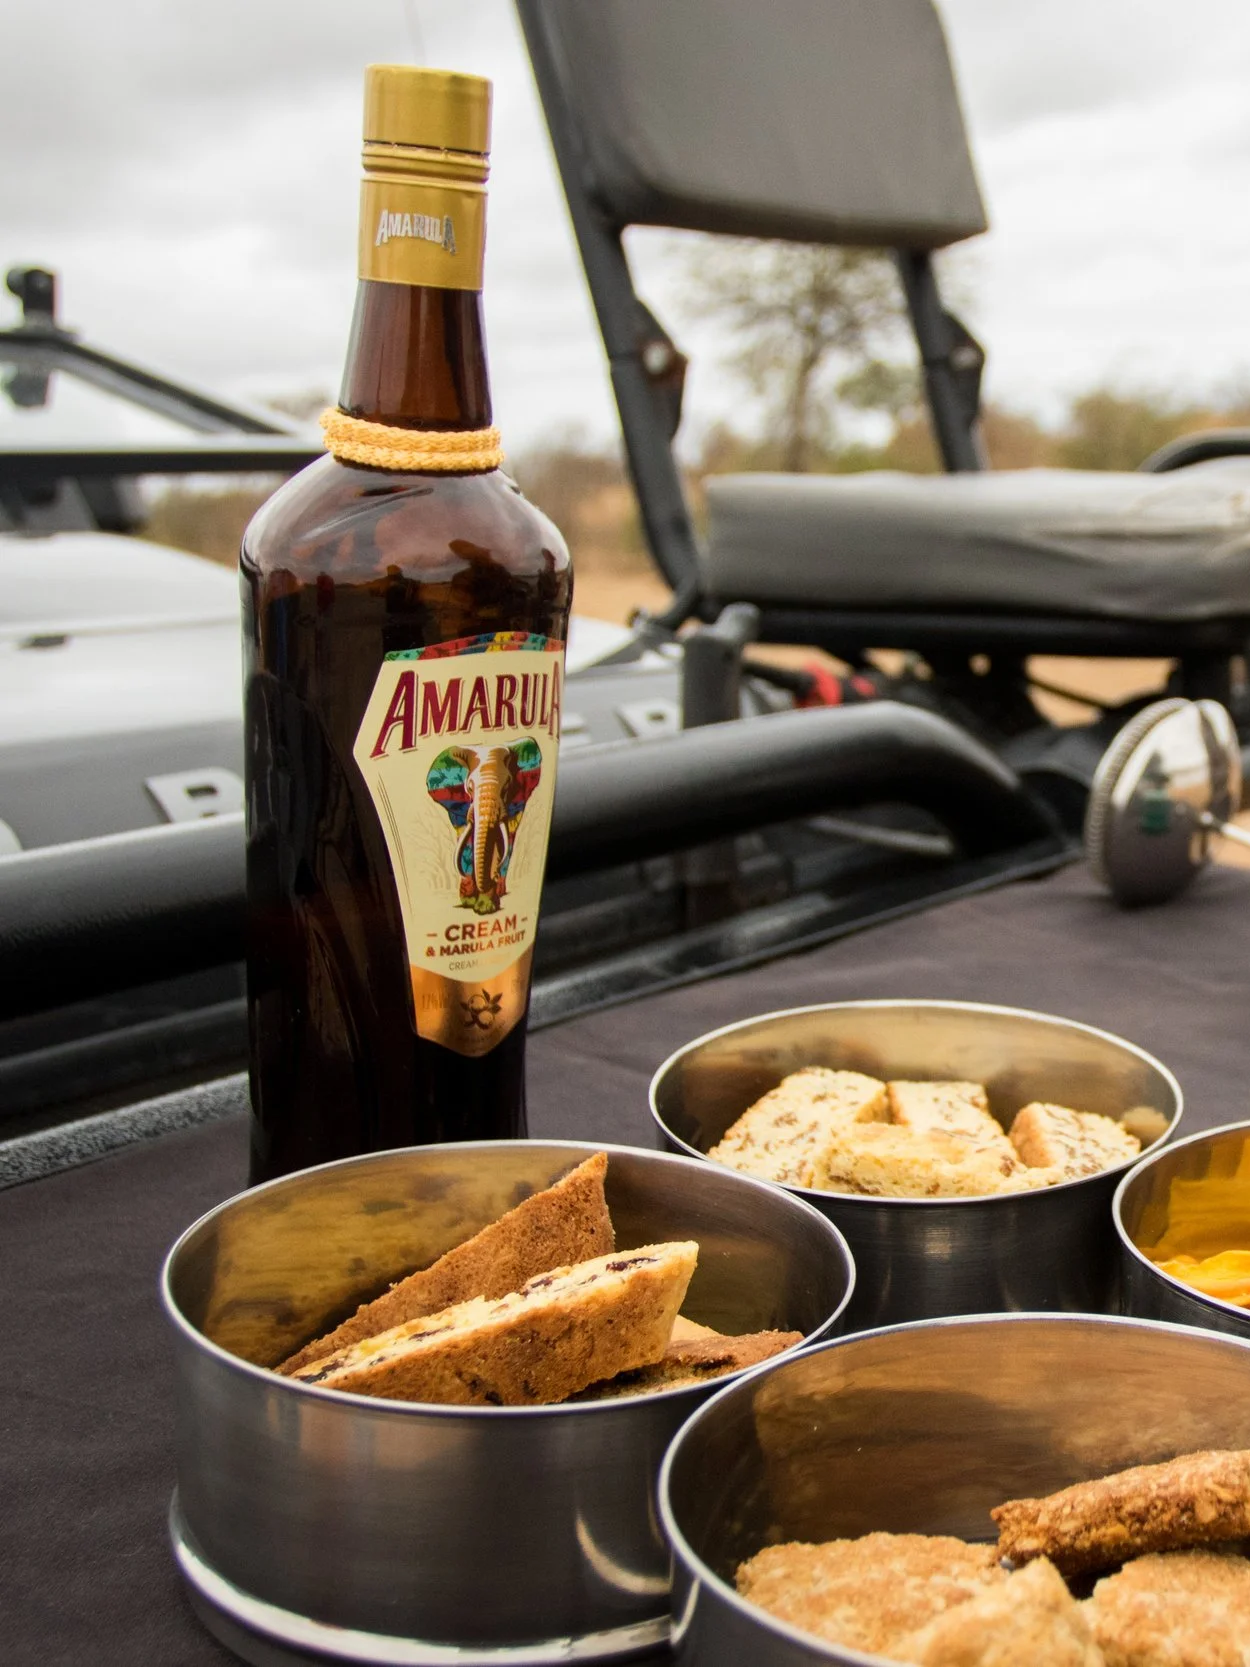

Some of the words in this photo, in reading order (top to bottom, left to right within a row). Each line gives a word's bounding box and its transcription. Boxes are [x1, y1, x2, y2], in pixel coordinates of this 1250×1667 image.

[375, 209, 456, 255] AMARULA
[370, 661, 560, 760] AMARULA
[426, 947, 435, 957] &
[439, 940, 493, 957] MARULA
[498, 930, 526, 948] FRUIT
[445, 914, 517, 941] CREAM
